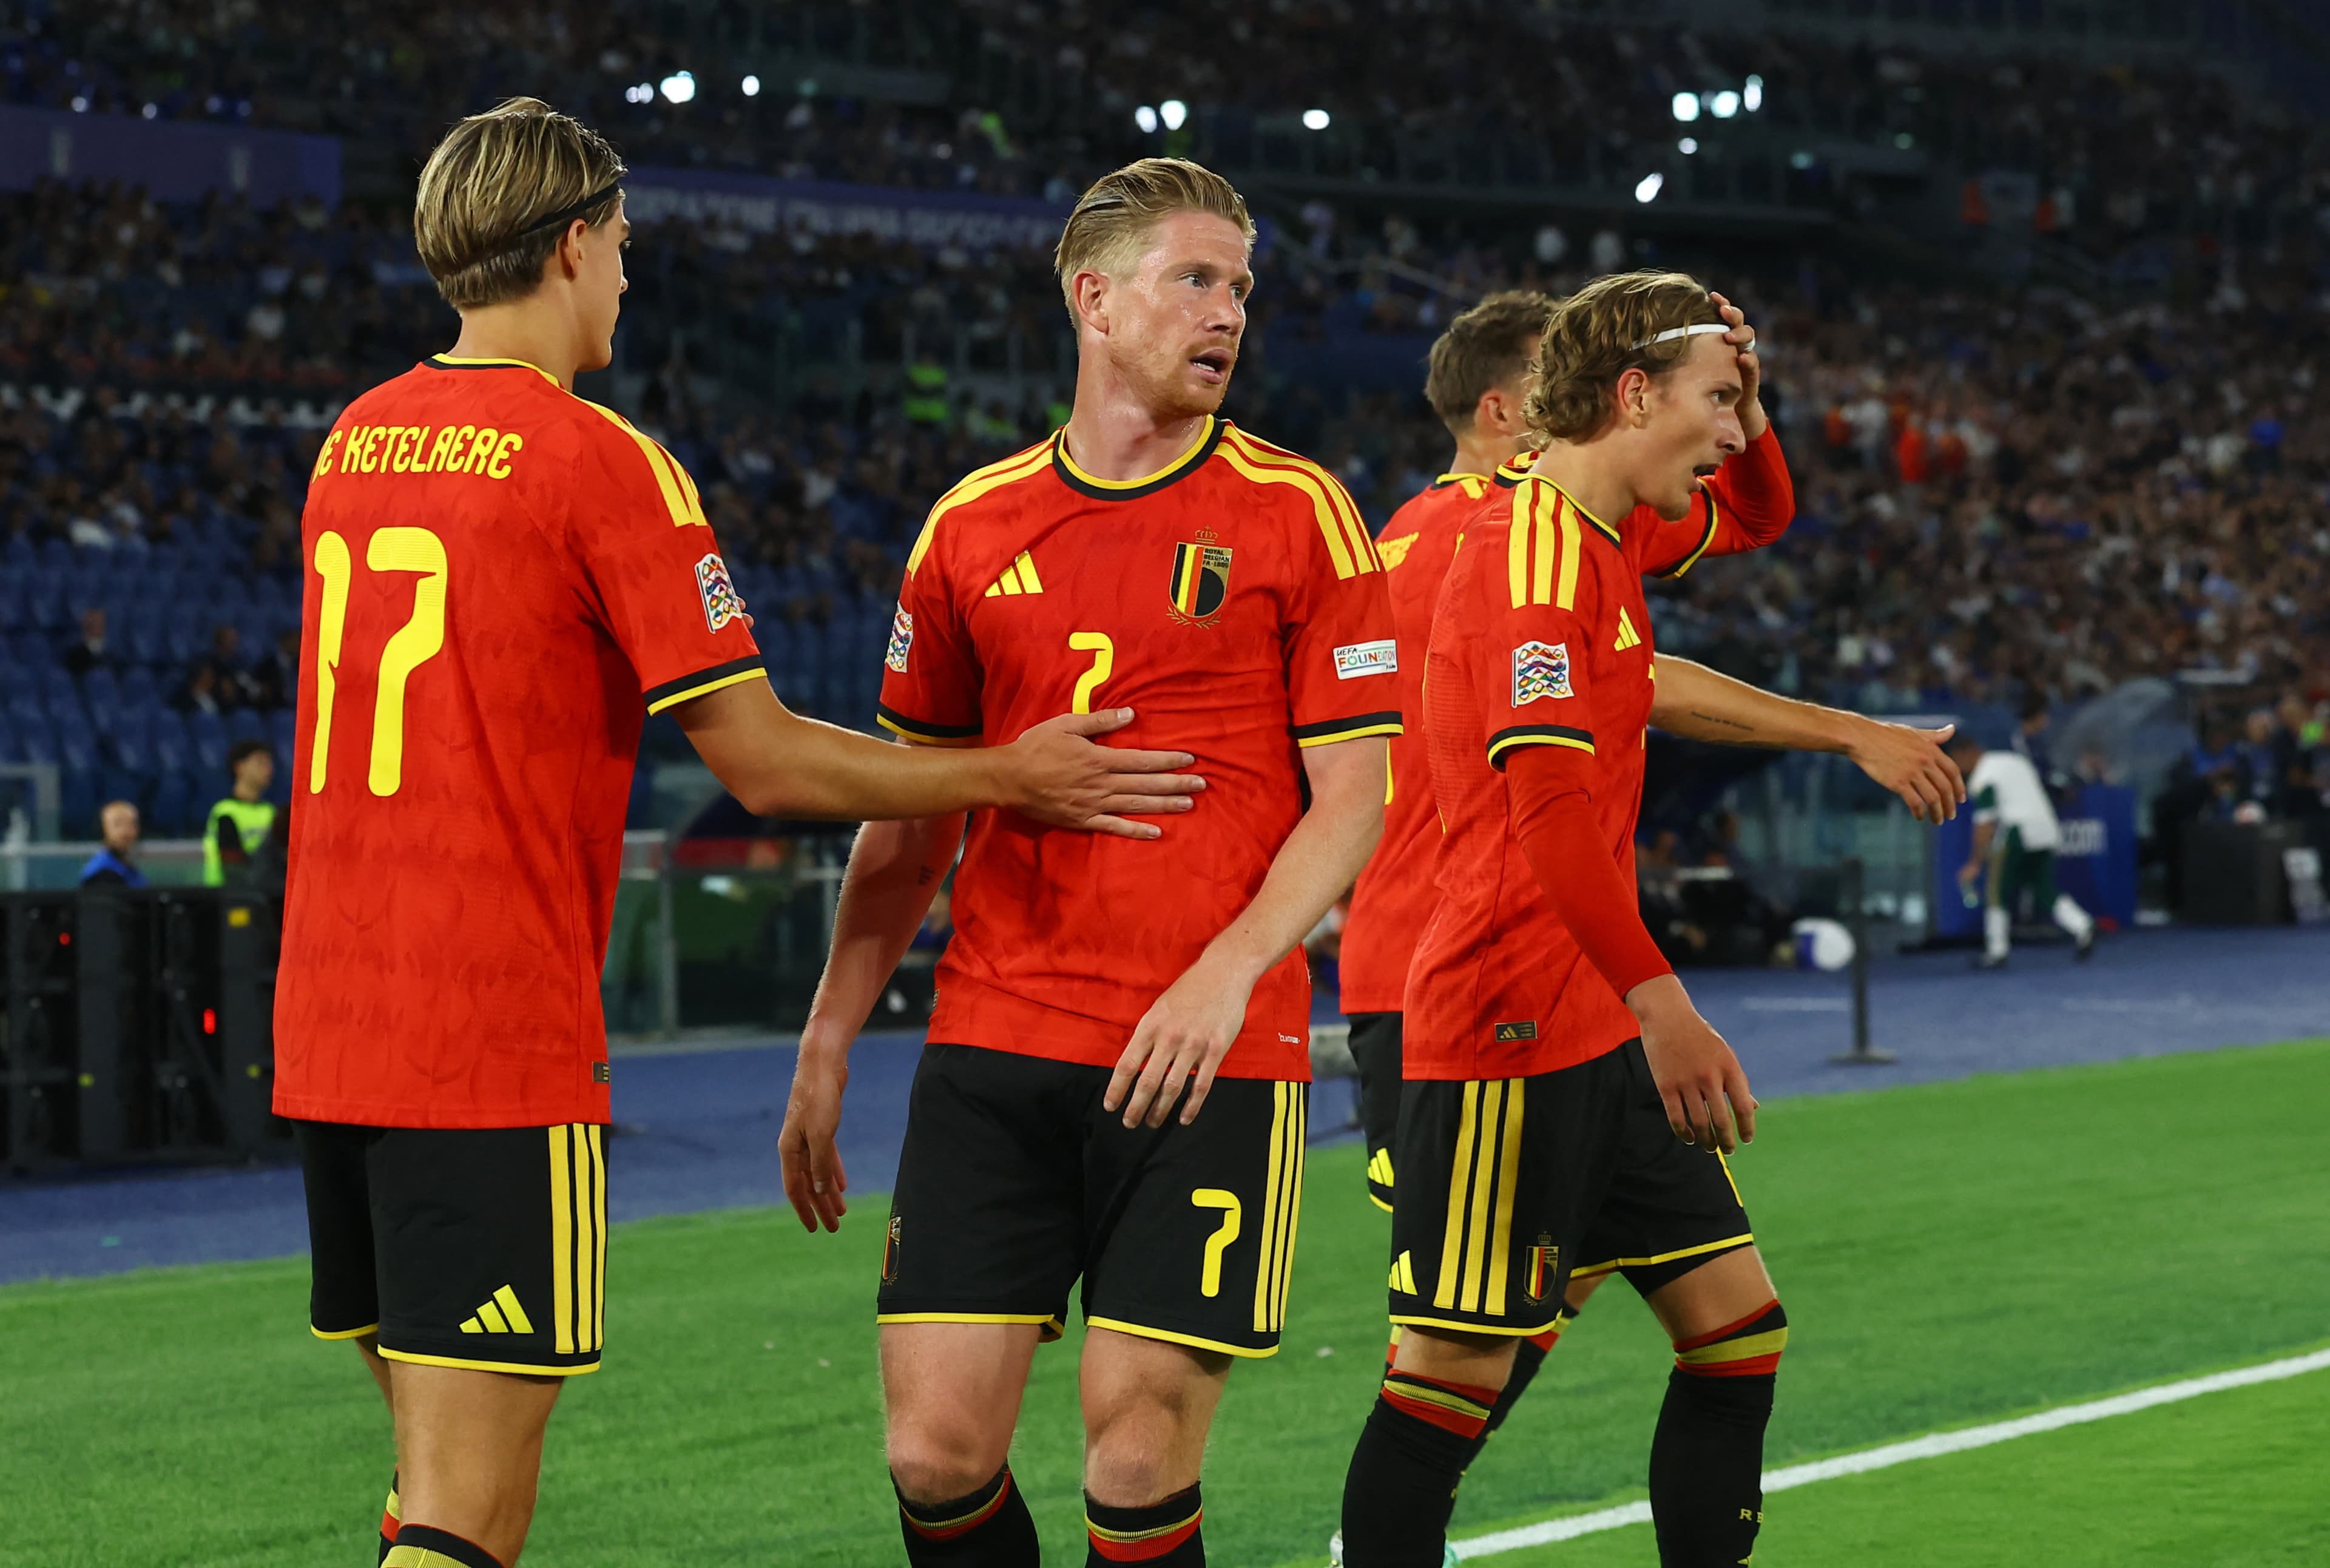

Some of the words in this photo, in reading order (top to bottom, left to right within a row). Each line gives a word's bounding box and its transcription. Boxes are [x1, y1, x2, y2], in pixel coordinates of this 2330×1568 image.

[340, 425, 523, 479] KETELAERE
[310, 526, 448, 797] 17
[1069, 632, 1113, 714] 7
[1337, 647, 1358, 656] UEFA
[1192, 1188, 1241, 1297] 7
